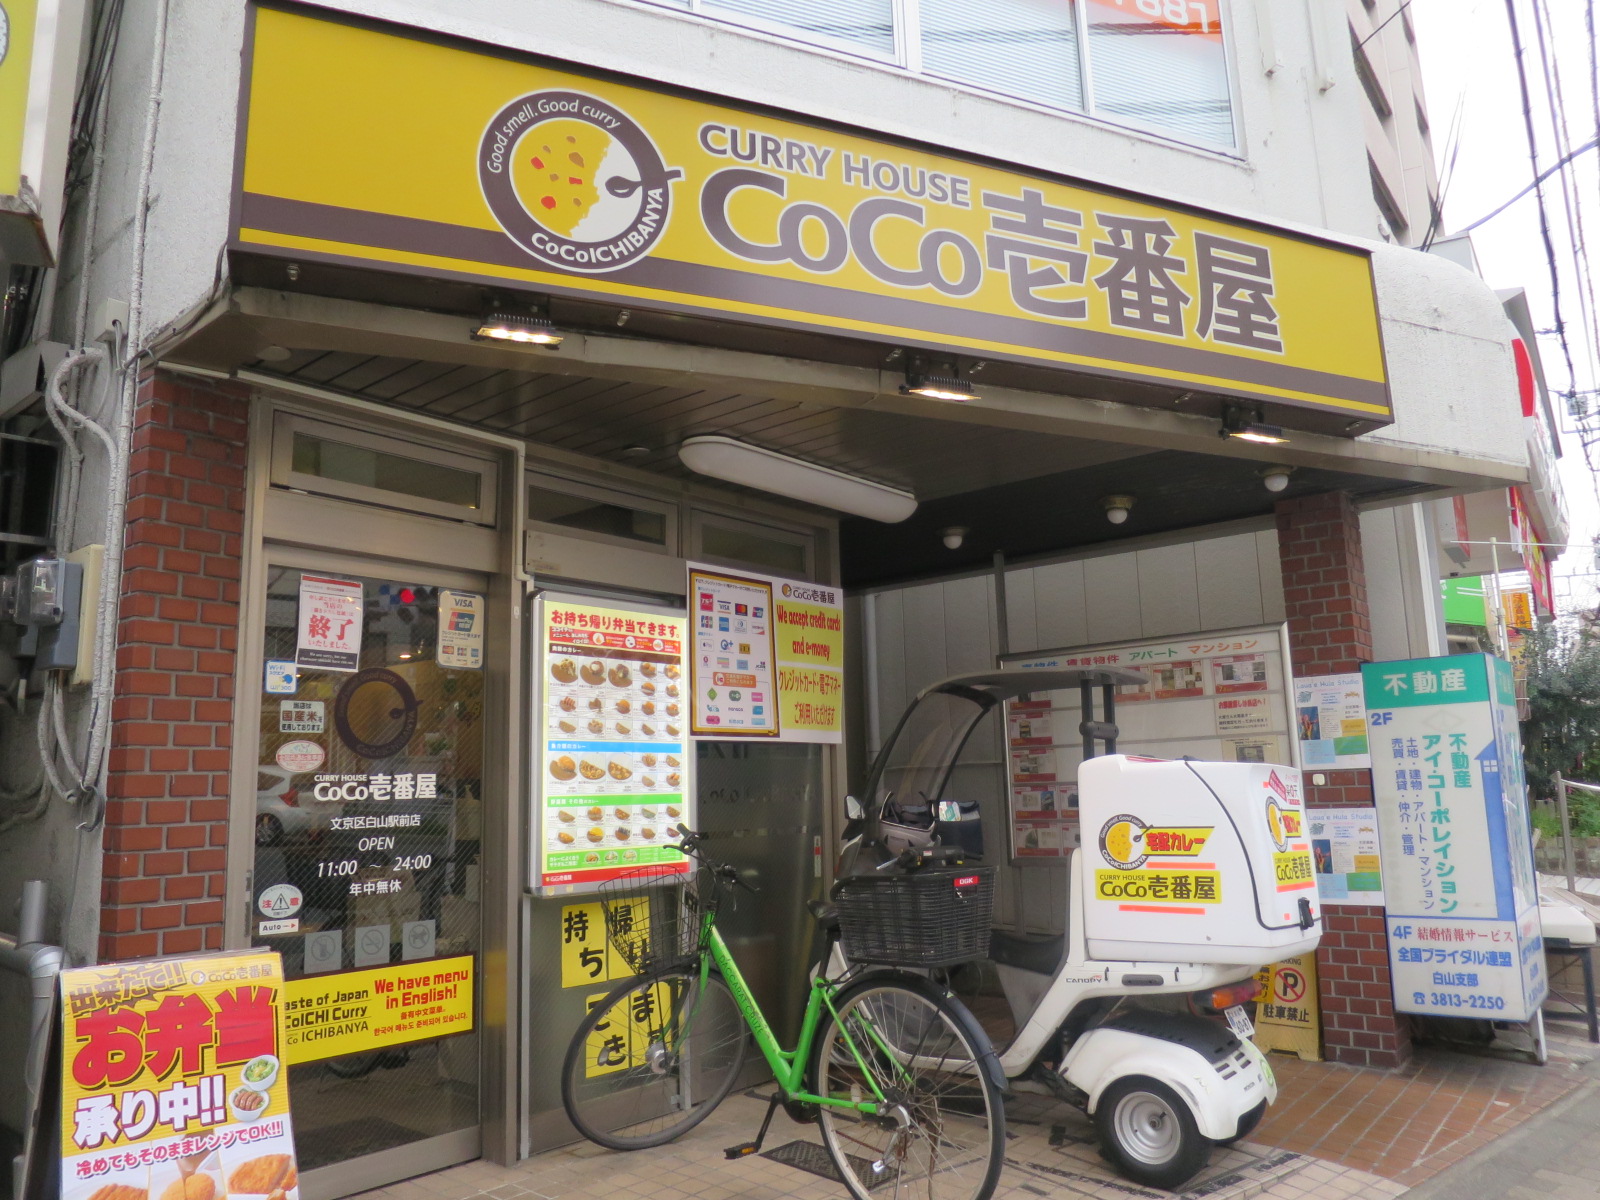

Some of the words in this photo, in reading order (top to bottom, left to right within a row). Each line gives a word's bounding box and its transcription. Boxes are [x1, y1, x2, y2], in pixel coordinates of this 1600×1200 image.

[486, 131, 508, 174] Good
[502, 104, 539, 139] smell.
[537, 97, 580, 116] Good
[581, 103, 622, 130] curry
[699, 123, 832, 180] CURRY
[843, 151, 971, 208] HOUSE
[530, 186, 664, 265] CoCoICHIBANYA
[700, 168, 1284, 355] CoCo壱番屋
[454, 598, 473, 608] VISA
[793, 589, 835, 604] CoCo壱番屋
[309, 614, 353, 640] 終了
[551, 610, 679, 638] お持ち帰り弁当できます。
[777, 604, 787, 624] We
[789, 610, 808, 630] accept
[810, 610, 826, 630] credit
[827, 613, 840, 632] cards
[793, 636, 805, 655] and
[806, 642, 830, 662] e-money
[1067, 654, 1119, 666] 賃貸物件
[1129, 647, 1178, 661] アパート
[1188, 639, 1258, 654] マンション
[1383, 668, 1467, 696] 不動産
[1371, 711, 1393, 726] 2F
[1449, 733, 1472, 788] 不動産
[313, 773, 437, 801] CoCo壱番屋
[314, 774, 340, 782] CURRY
[341, 774, 367, 782] HOUSE
[1391, 738, 1415, 856] 売買・賃貸・仲介・管理
[330, 814, 421, 830] 文京区白山駅前店
[1132, 818, 1142, 828] curry
[1406, 737, 1435, 910] 土地・建物・アパート・マンション
[1422, 734, 1458, 913] アイ・コーポレイション
[358, 836, 395, 851] OPEN
[1146, 832, 1205, 851] 宅配カレー
[317, 860, 358, 877] 11:00
[392, 854, 432, 872] 24:00
[1277, 856, 1312, 881] CoCo壱番屋
[349, 880, 402, 897] 年中無休
[960, 877, 973, 885] OGK
[1100, 875, 1216, 900] CoCo壱番屋
[1393, 926, 1412, 940] 4F
[1417, 927, 1514, 943] 結婚情報サービス
[1397, 947, 1513, 967] 全国ブライダル連盟
[209, 964, 273, 983] CoCo壱番屋
[374, 979, 393, 994] We
[397, 975, 430, 991] have
[433, 970, 469, 985] menu
[1432, 972, 1479, 987] 白山支部
[285, 996, 313, 1010] aste
[316, 993, 329, 1006] of
[332, 990, 368, 1004] Japan
[386, 996, 398, 1009] in
[402, 984, 457, 1007] English!
[1431, 992, 1504, 1010] 3813-2250
[332, 1006, 367, 1021] Curry
[1263, 1004, 1310, 1022] 駐車禁止
[73, 986, 277, 1088] お弁当
[301, 1021, 369, 1042] ICHIBANYA
[373, 1027, 394, 1037] 한국어
[72, 1074, 226, 1149] 承り中!!
[76, 1121, 283, 1178] 冷めてもそのままレンジでOK!!
